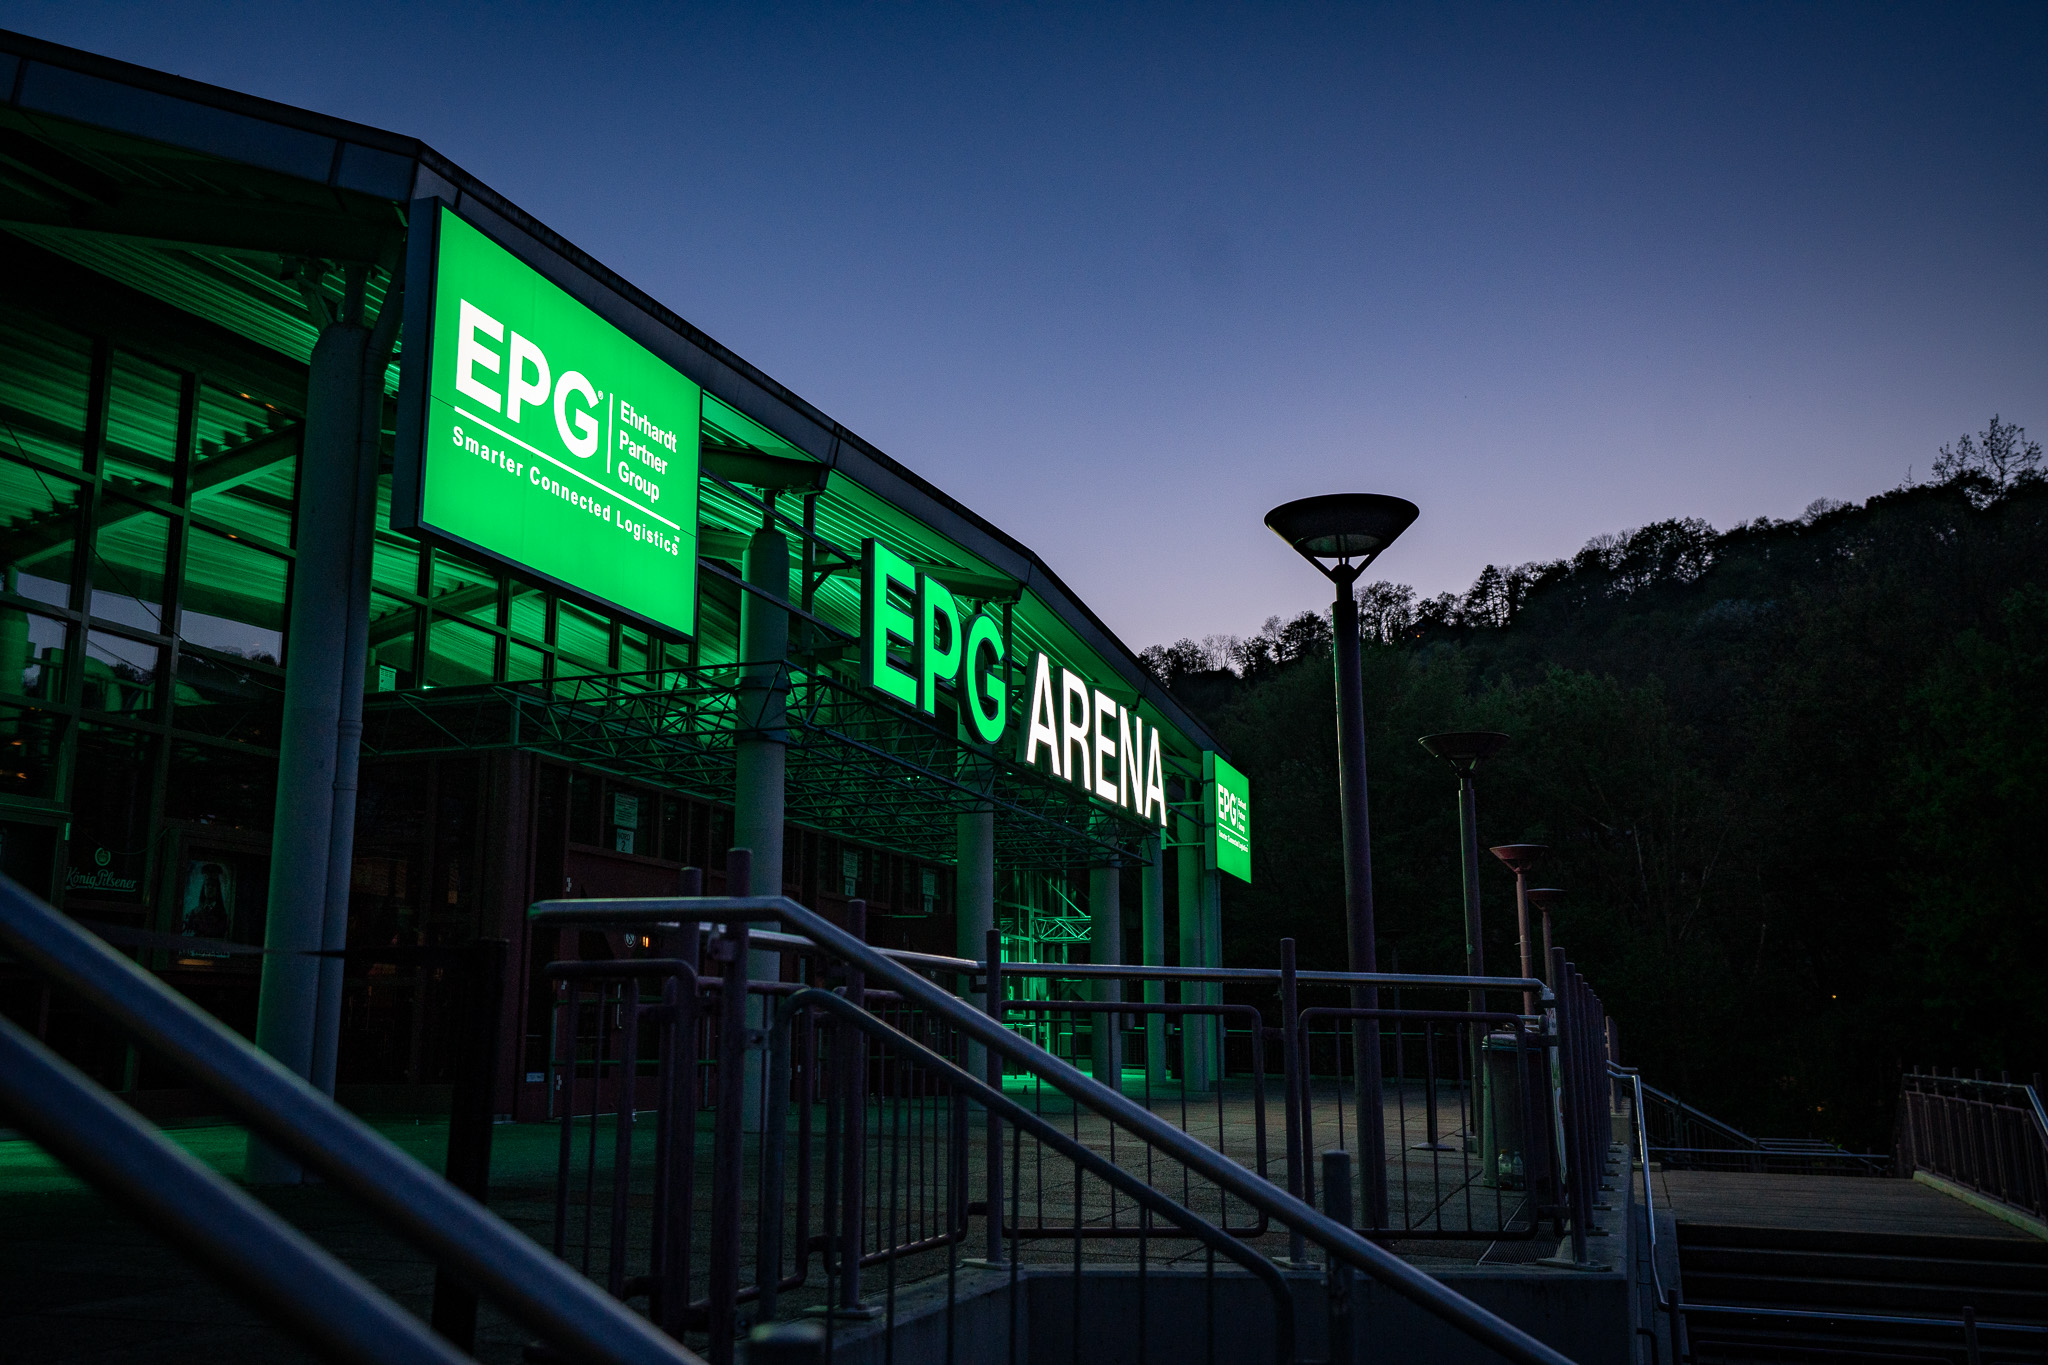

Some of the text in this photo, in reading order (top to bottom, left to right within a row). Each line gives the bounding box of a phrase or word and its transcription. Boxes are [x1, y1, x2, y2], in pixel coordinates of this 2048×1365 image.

[621, 400, 678, 453] Ehrhardt
[453, 426, 523, 477] Smarter
[530, 466, 610, 522] Connected
[619, 430, 668, 475] Partner
[618, 461, 660, 503] Group
[871, 540, 1167, 827] EPG ARENA
[1218, 783, 1236, 826] EPG
